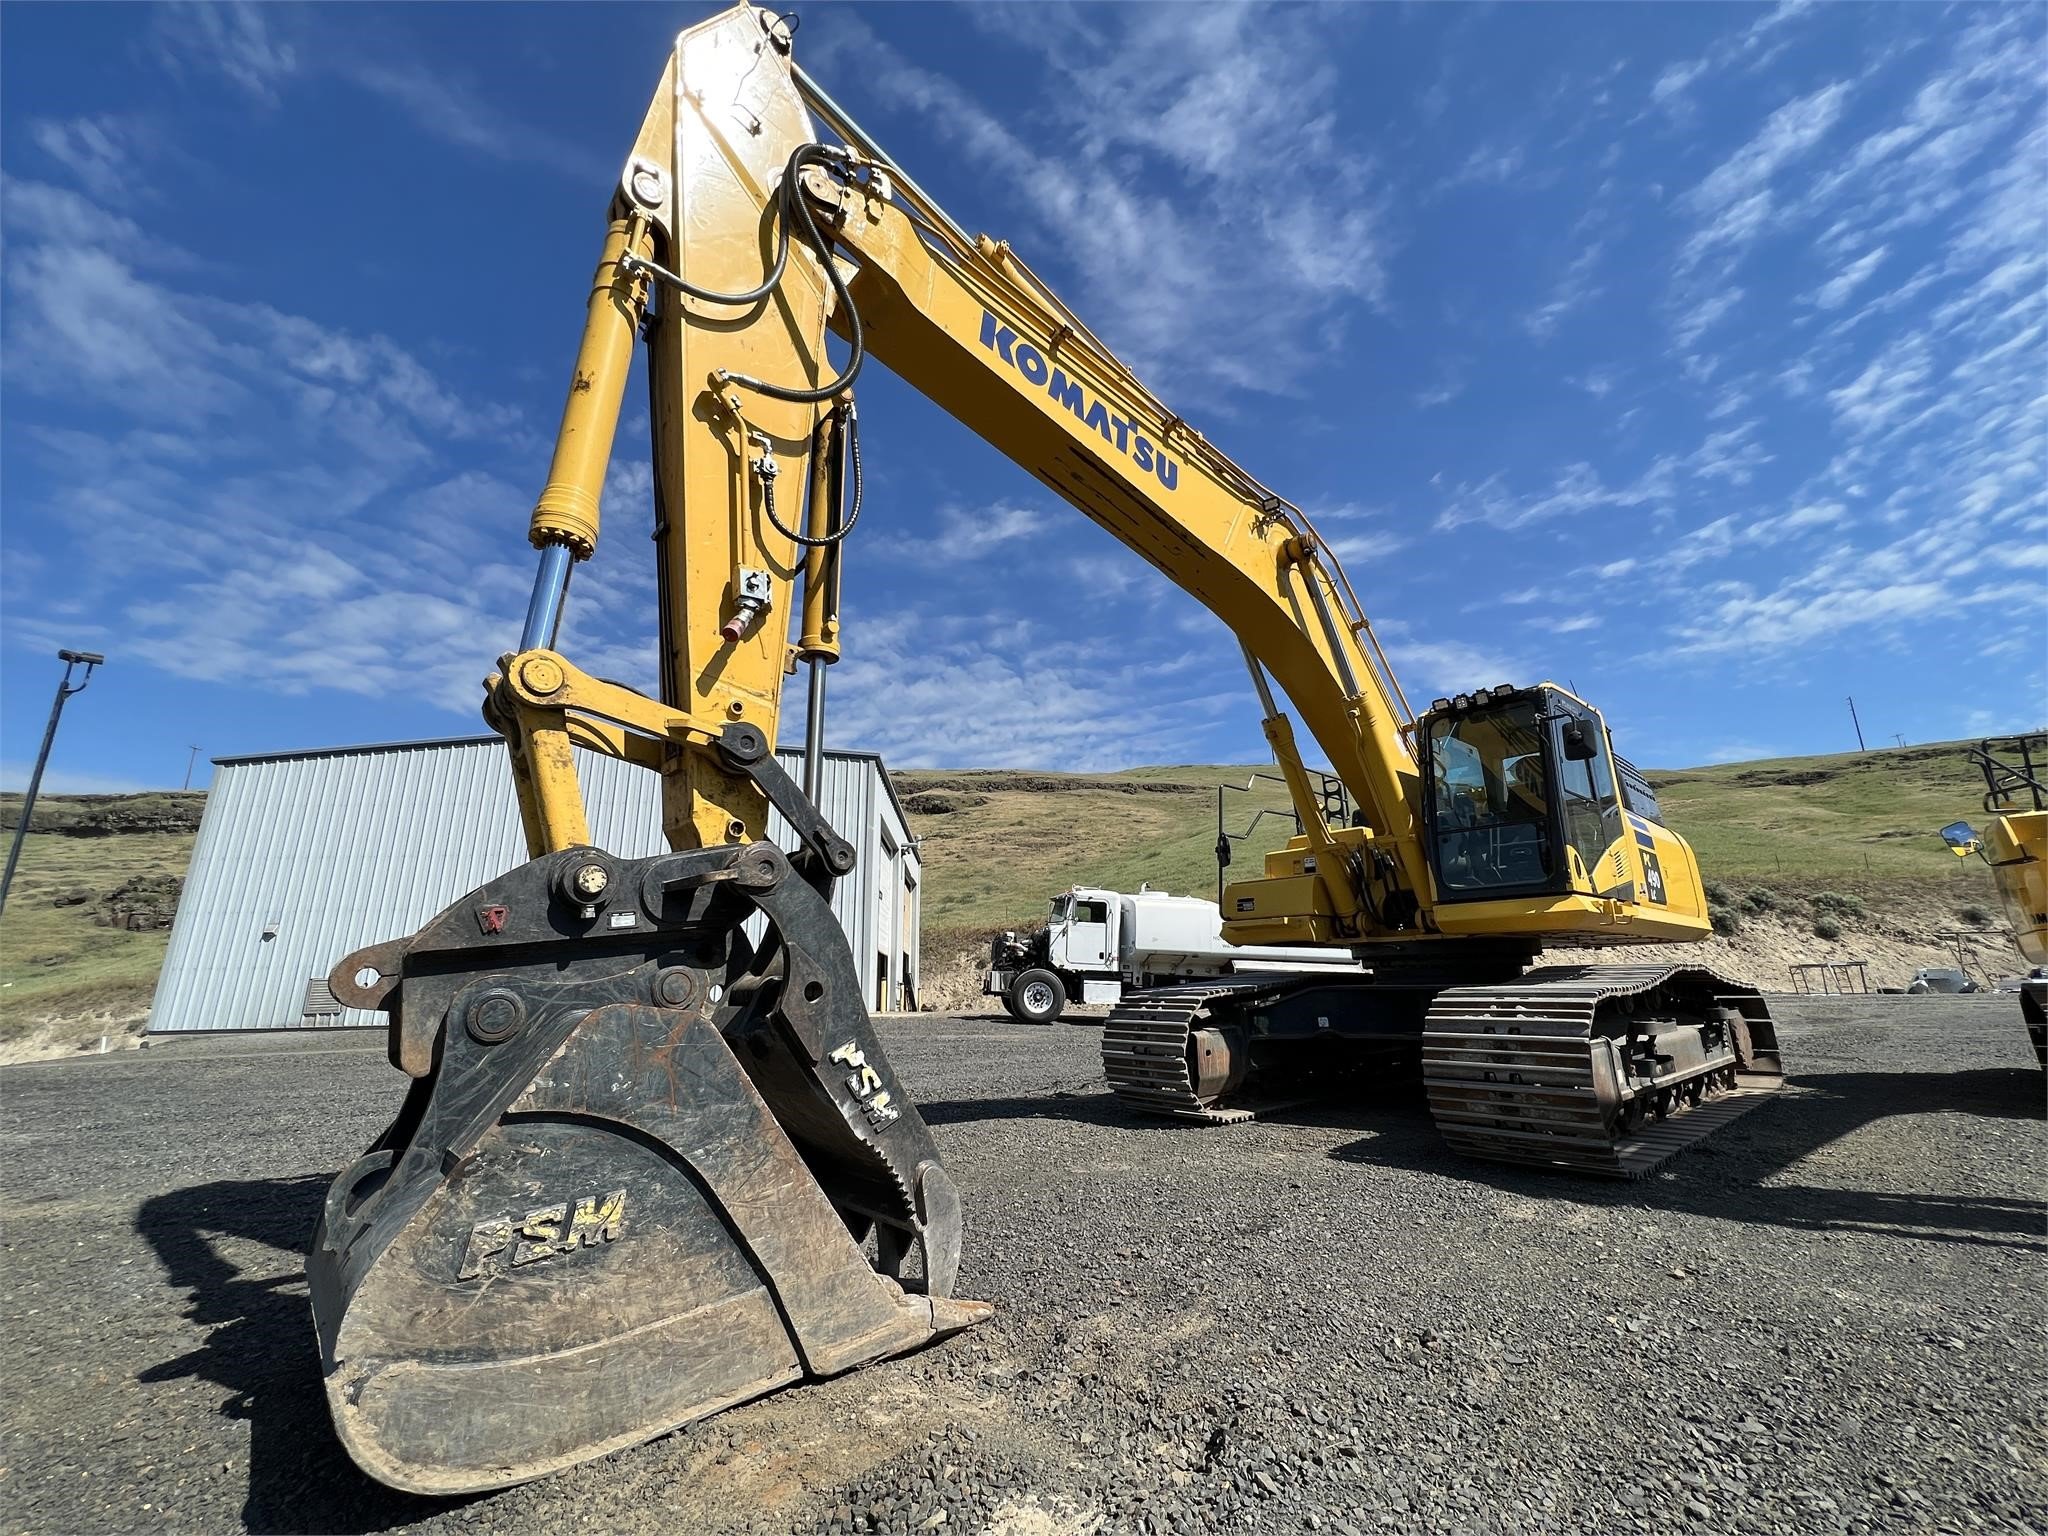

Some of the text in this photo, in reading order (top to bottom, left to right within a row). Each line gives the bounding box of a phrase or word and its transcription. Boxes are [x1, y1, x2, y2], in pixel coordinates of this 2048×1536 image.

[979, 310, 1178, 491] KOMATSU
[1648, 869, 1660, 889] 490
[828, 1038, 901, 1133] PSM
[457, 1190, 627, 1283] PSM
